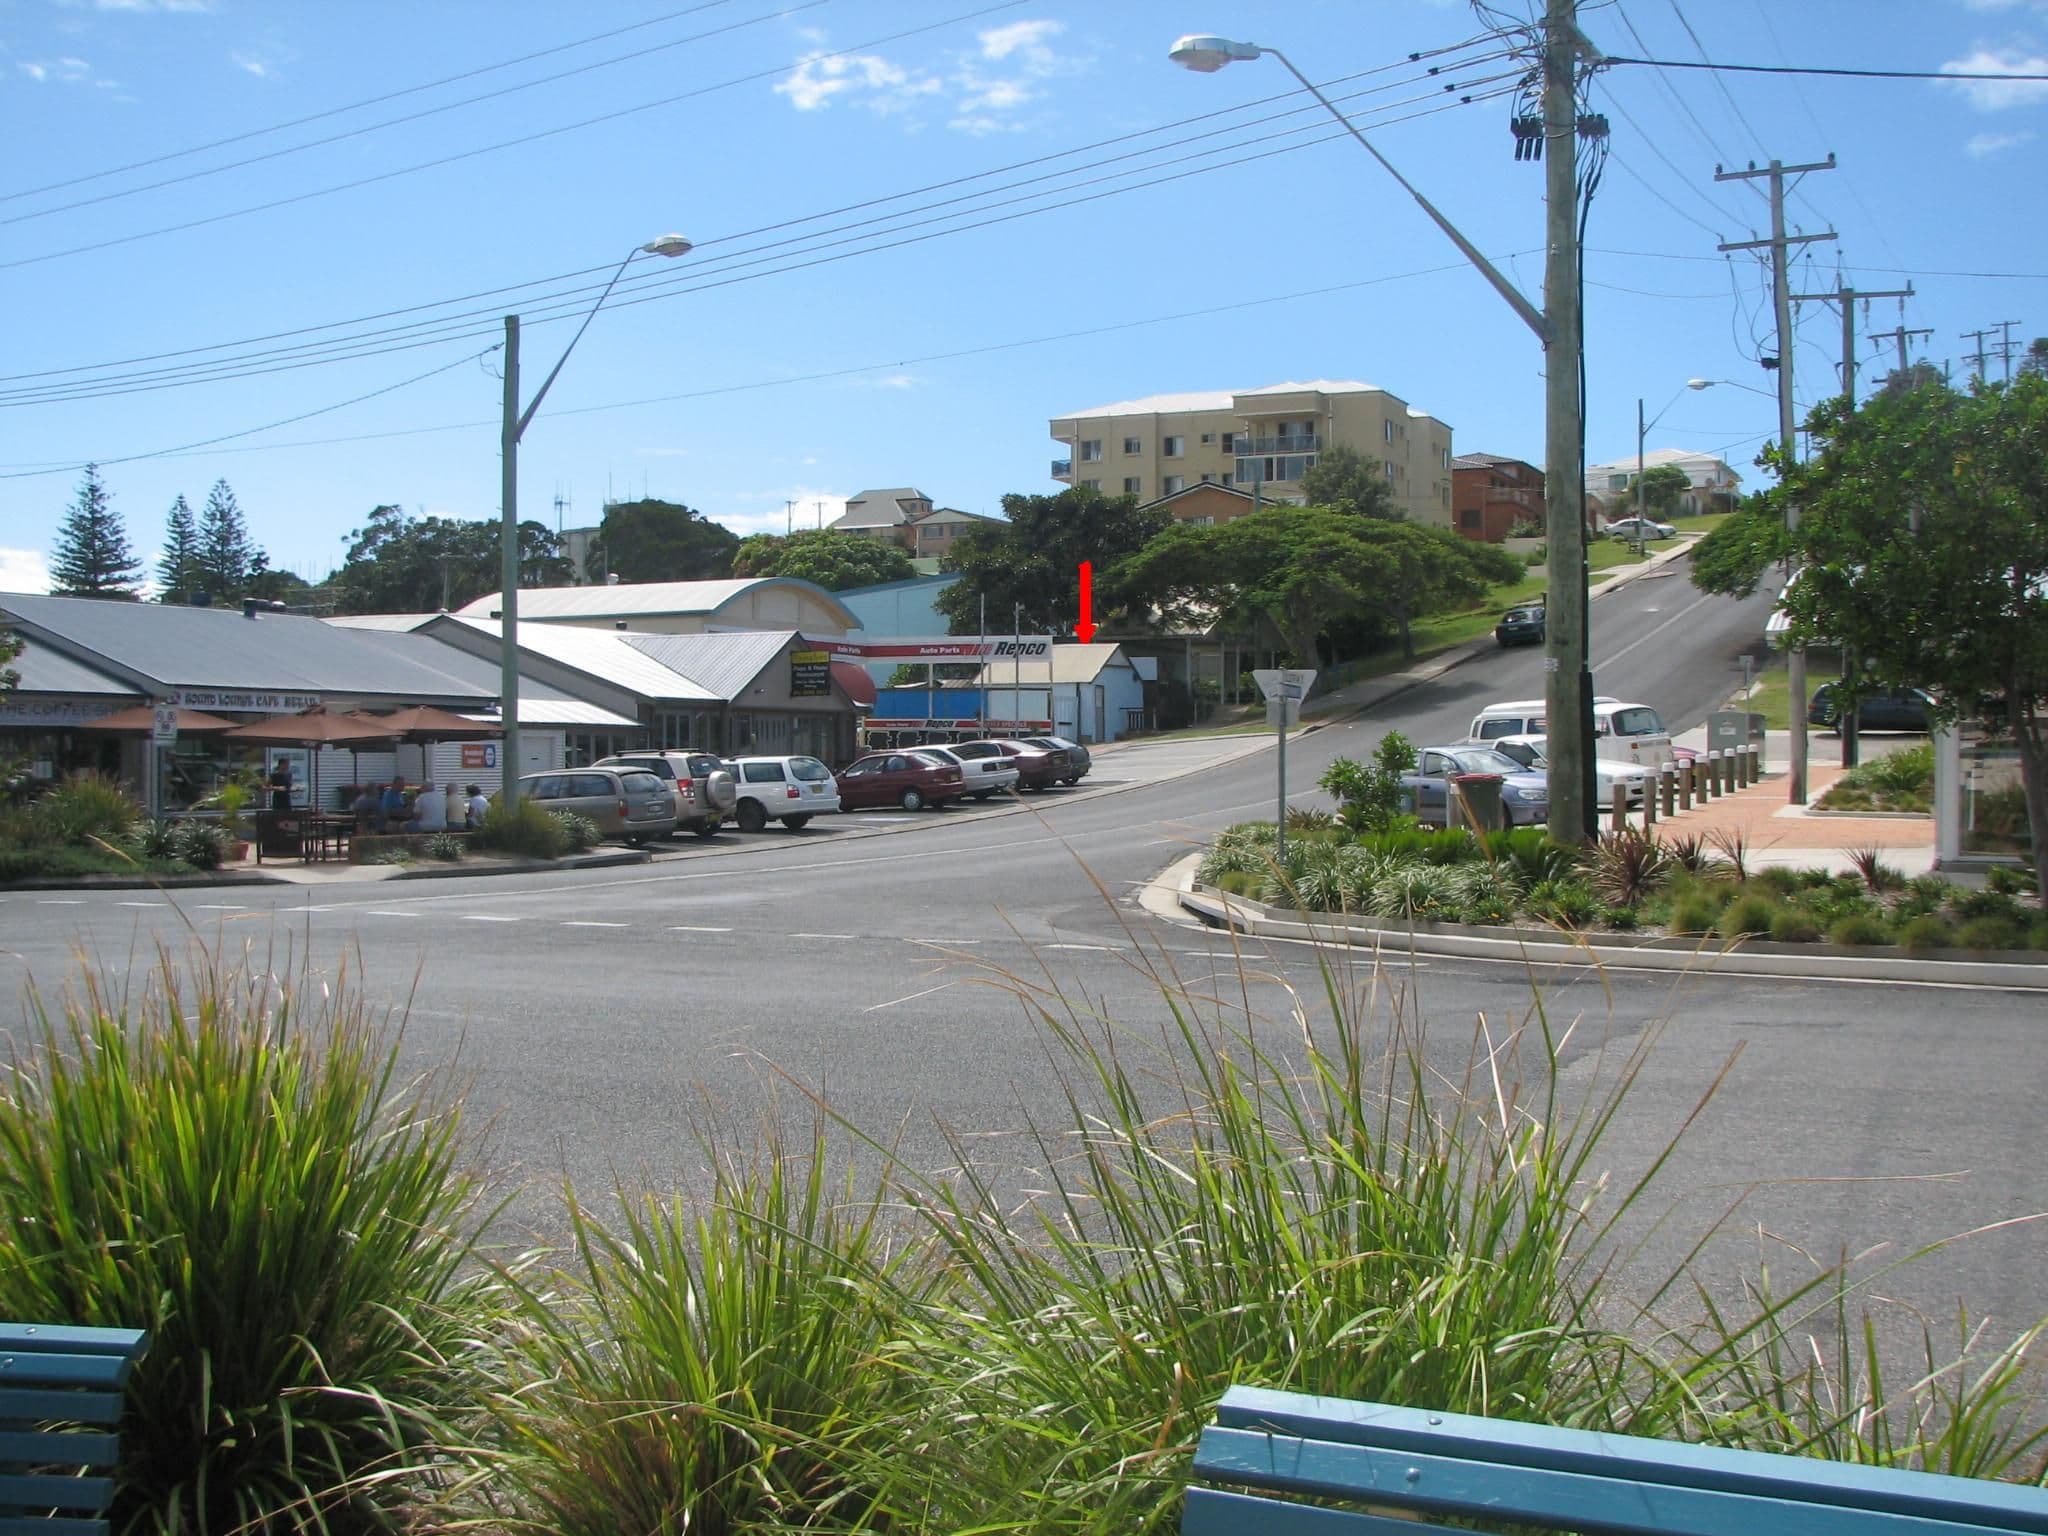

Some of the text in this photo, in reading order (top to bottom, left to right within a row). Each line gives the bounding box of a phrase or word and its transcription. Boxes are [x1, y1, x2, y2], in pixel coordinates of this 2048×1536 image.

[920, 647, 960, 655] Auto Parts
[994, 641, 1047, 659] Repco
[925, 719, 954, 729] Repco
